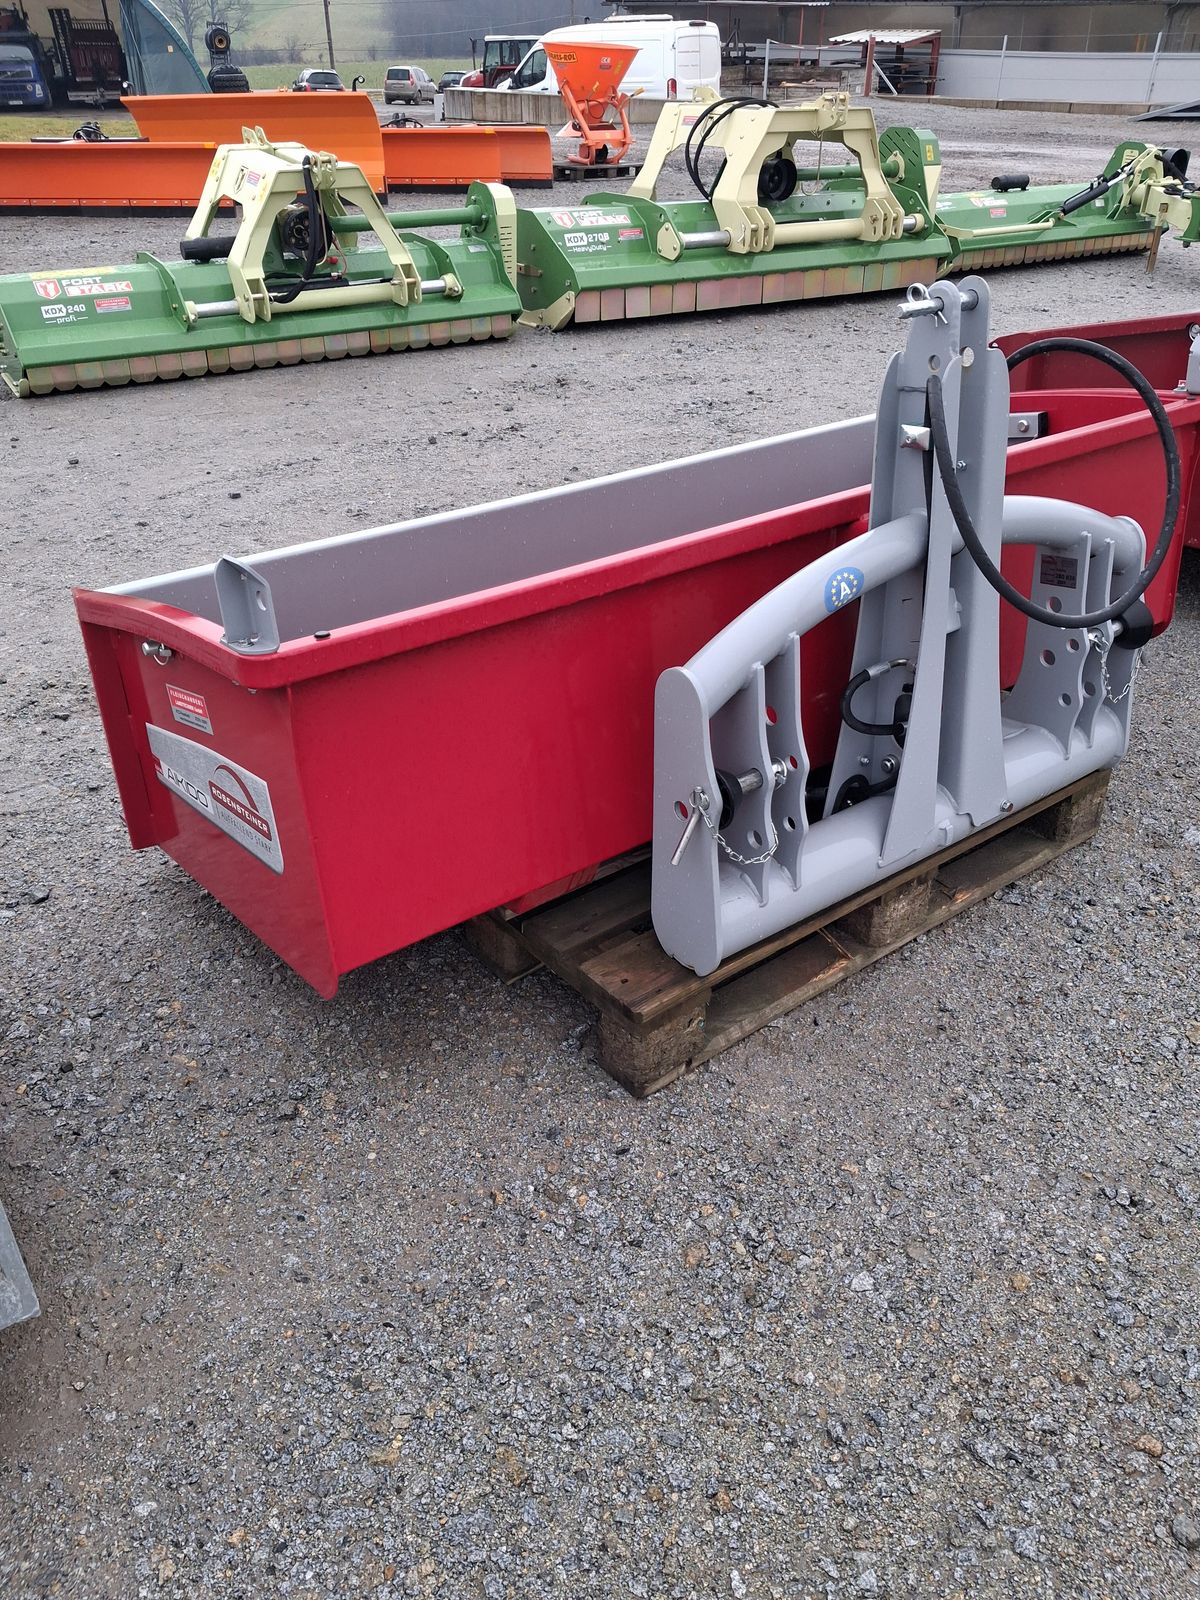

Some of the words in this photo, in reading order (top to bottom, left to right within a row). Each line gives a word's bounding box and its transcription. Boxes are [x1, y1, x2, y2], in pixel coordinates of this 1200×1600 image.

[566, 234, 585, 244] KDX
[573, 244, 607, 252] HeavyDuty
[61, 276, 102, 287] FORT
[43, 306, 64, 316] KDX
[66, 304, 86, 314] 240
[56, 315, 77, 324] profi
[840, 581, 851, 600] A
[167, 768, 209, 808] AIKIDO
[211, 787, 269, 834] ROSENSTEINER
